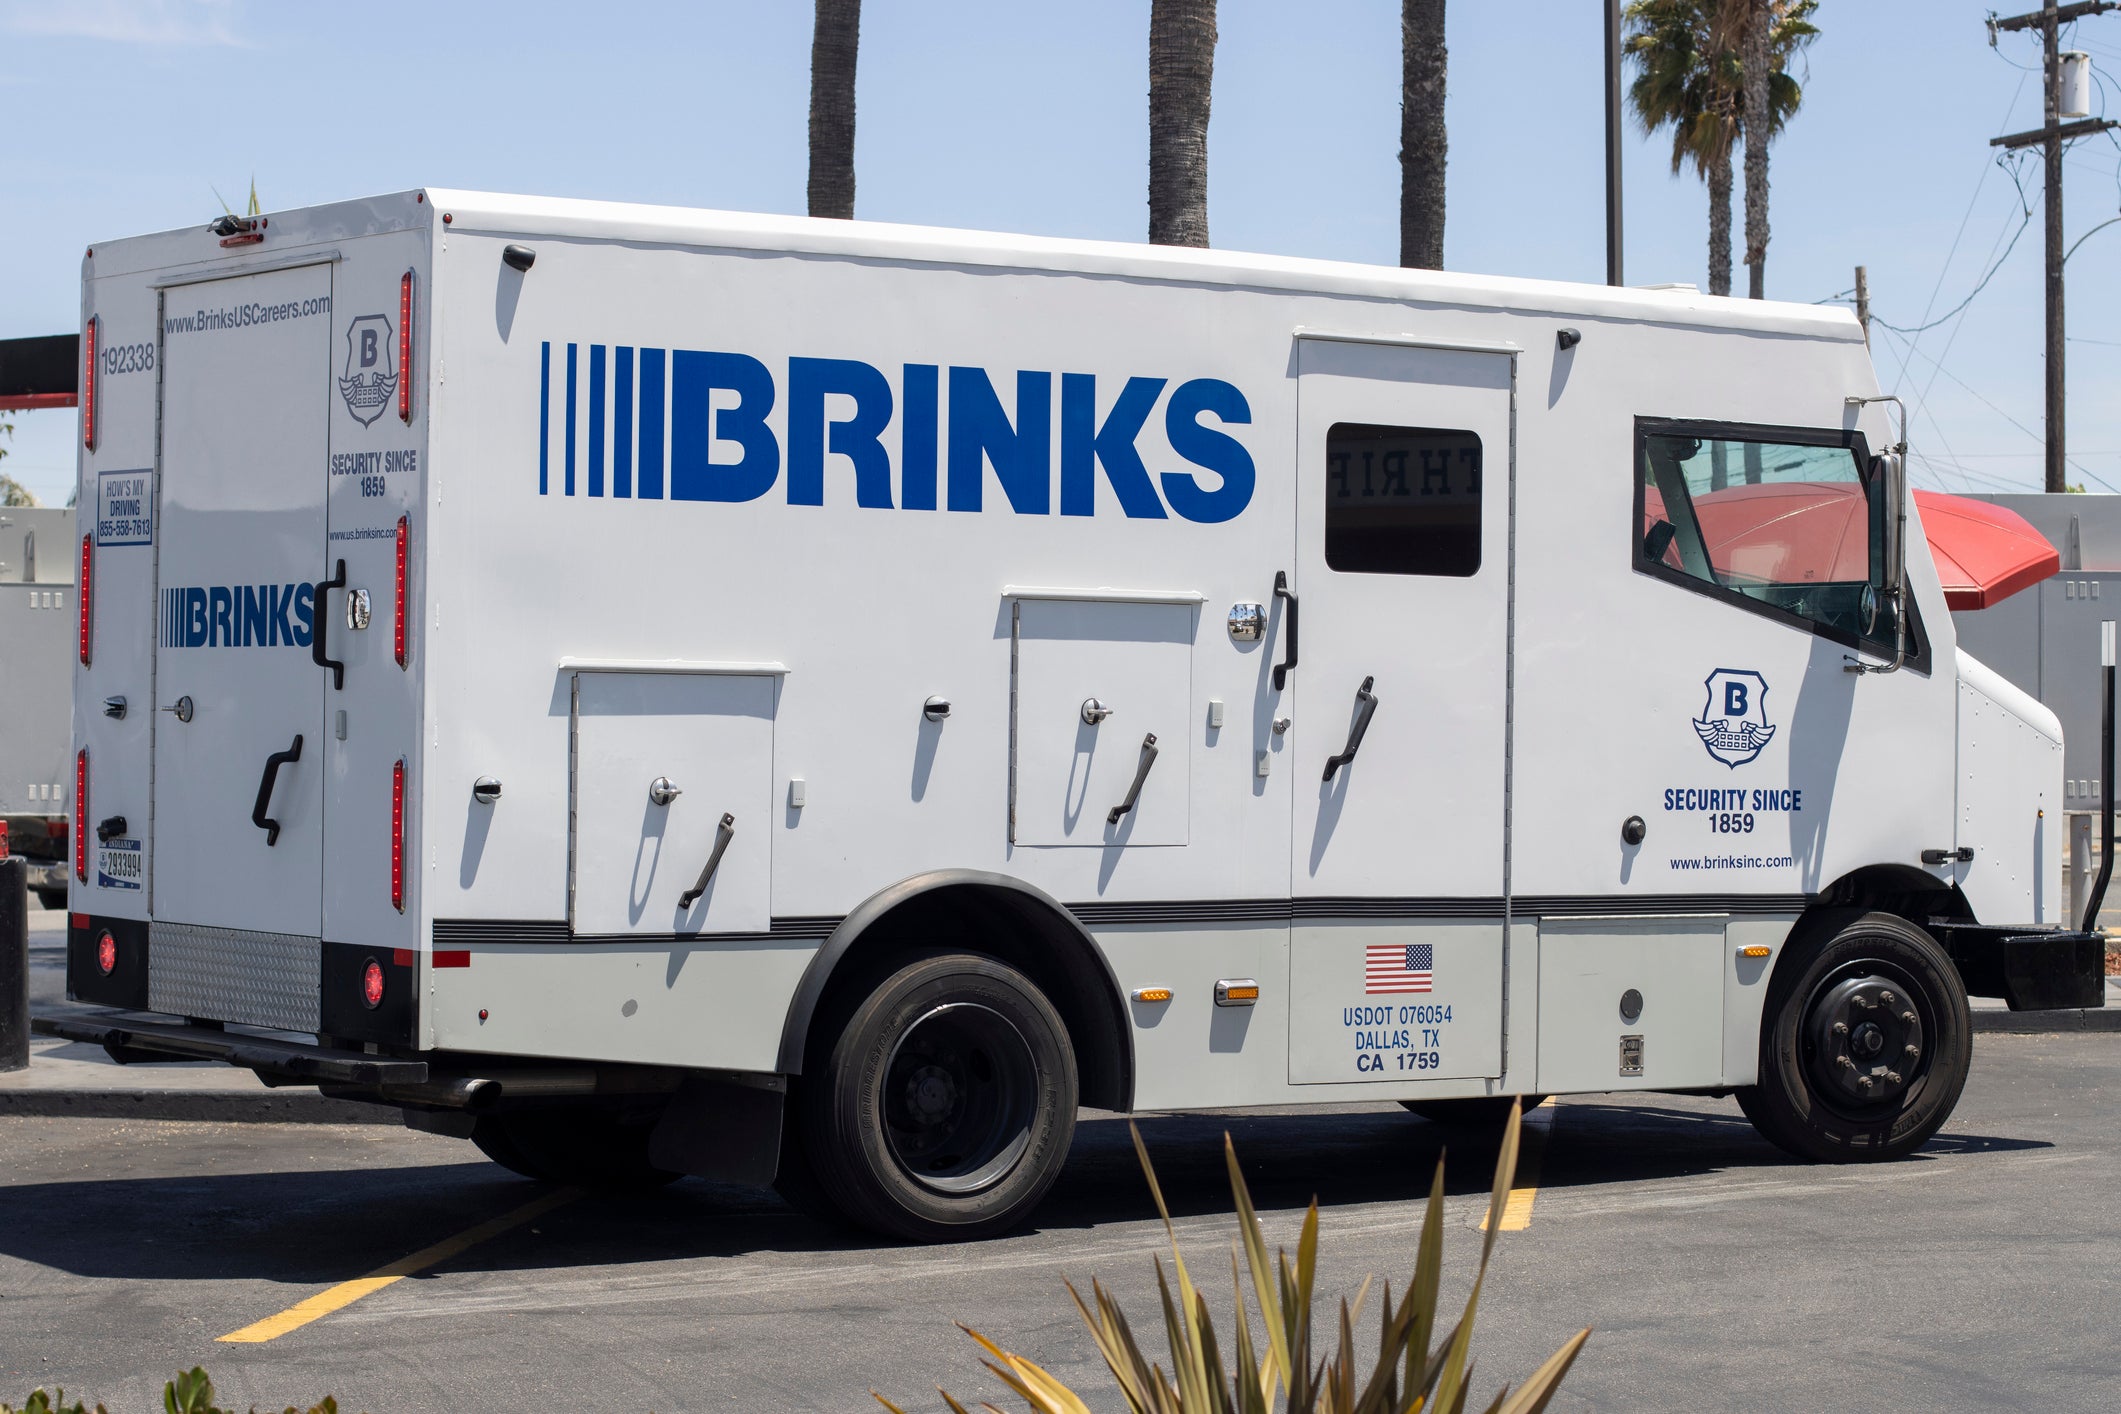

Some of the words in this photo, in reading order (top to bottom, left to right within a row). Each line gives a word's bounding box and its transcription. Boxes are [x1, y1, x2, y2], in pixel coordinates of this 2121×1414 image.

[166, 296, 331, 334] www.BrinksUSCareers.com
[102, 342, 155, 375] 192338
[360, 328, 377, 368] B
[671, 349, 1256, 524] BRINKS
[331, 451, 382, 476] SECURITY
[385, 450, 417, 472] SINCE
[106, 480, 131, 497] HOW'S
[133, 479, 145, 496] MY
[360, 476, 386, 498] 1859
[110, 499, 140, 517] DRIVING
[100, 519, 150, 537] 855-558-7613
[186, 582, 314, 648] BRINKS
[1724, 681, 1748, 717] B
[1664, 788, 1747, 811] SECURITY
[1752, 789, 1802, 811] SINCE
[1708, 813, 1755, 834] 1859
[108, 852, 141, 878] 2933994
[1670, 855, 1793, 870] www.brinksinc.com
[1344, 1007, 1393, 1027] USDOT
[1400, 1004, 1453, 1025] 076054
[1356, 1030, 1415, 1051] DALLAS,
[1422, 1029, 1440, 1047] TX
[1356, 1053, 1384, 1073] CA
[1396, 1052, 1440, 1070] 1759
